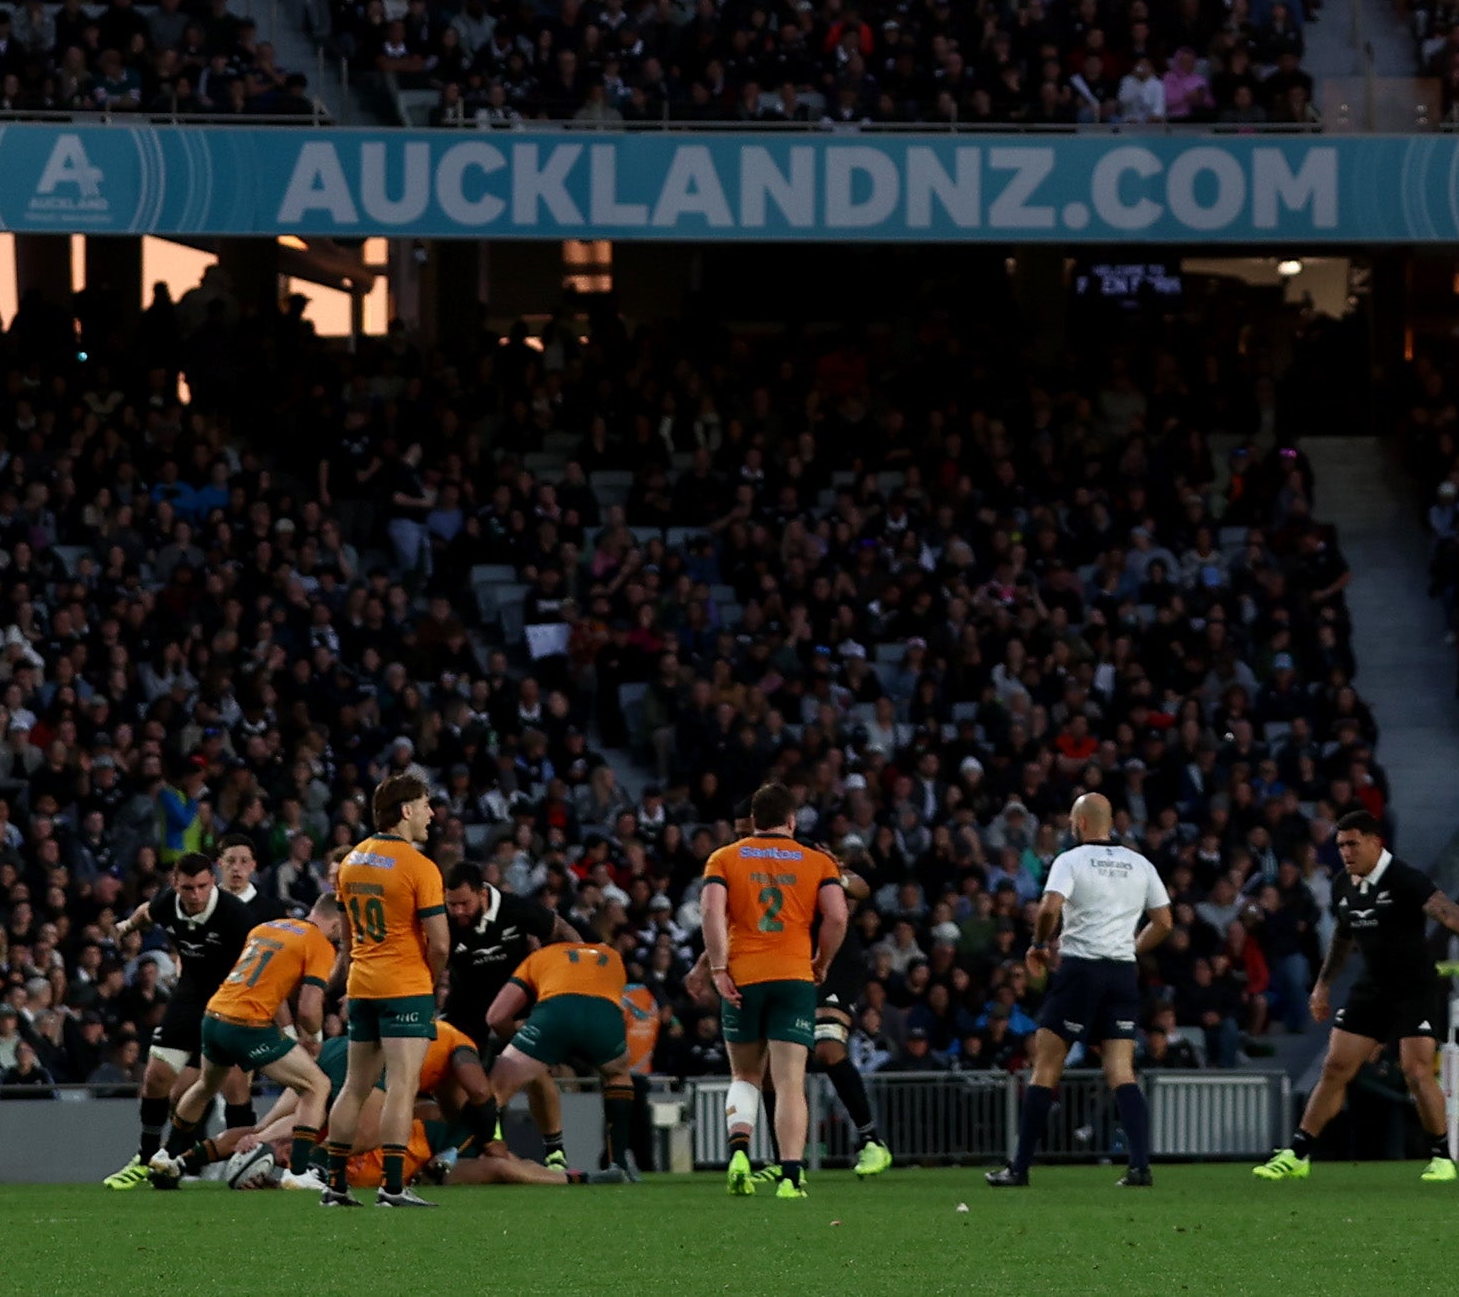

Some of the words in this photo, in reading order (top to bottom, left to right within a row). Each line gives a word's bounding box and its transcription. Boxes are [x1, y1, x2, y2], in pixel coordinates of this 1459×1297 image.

[277, 141, 1339, 230] AUCKLANDNZ.COM
[740, 845, 804, 862] Santos
[350, 898, 386, 943] 10
[759, 886, 784, 933] 2
